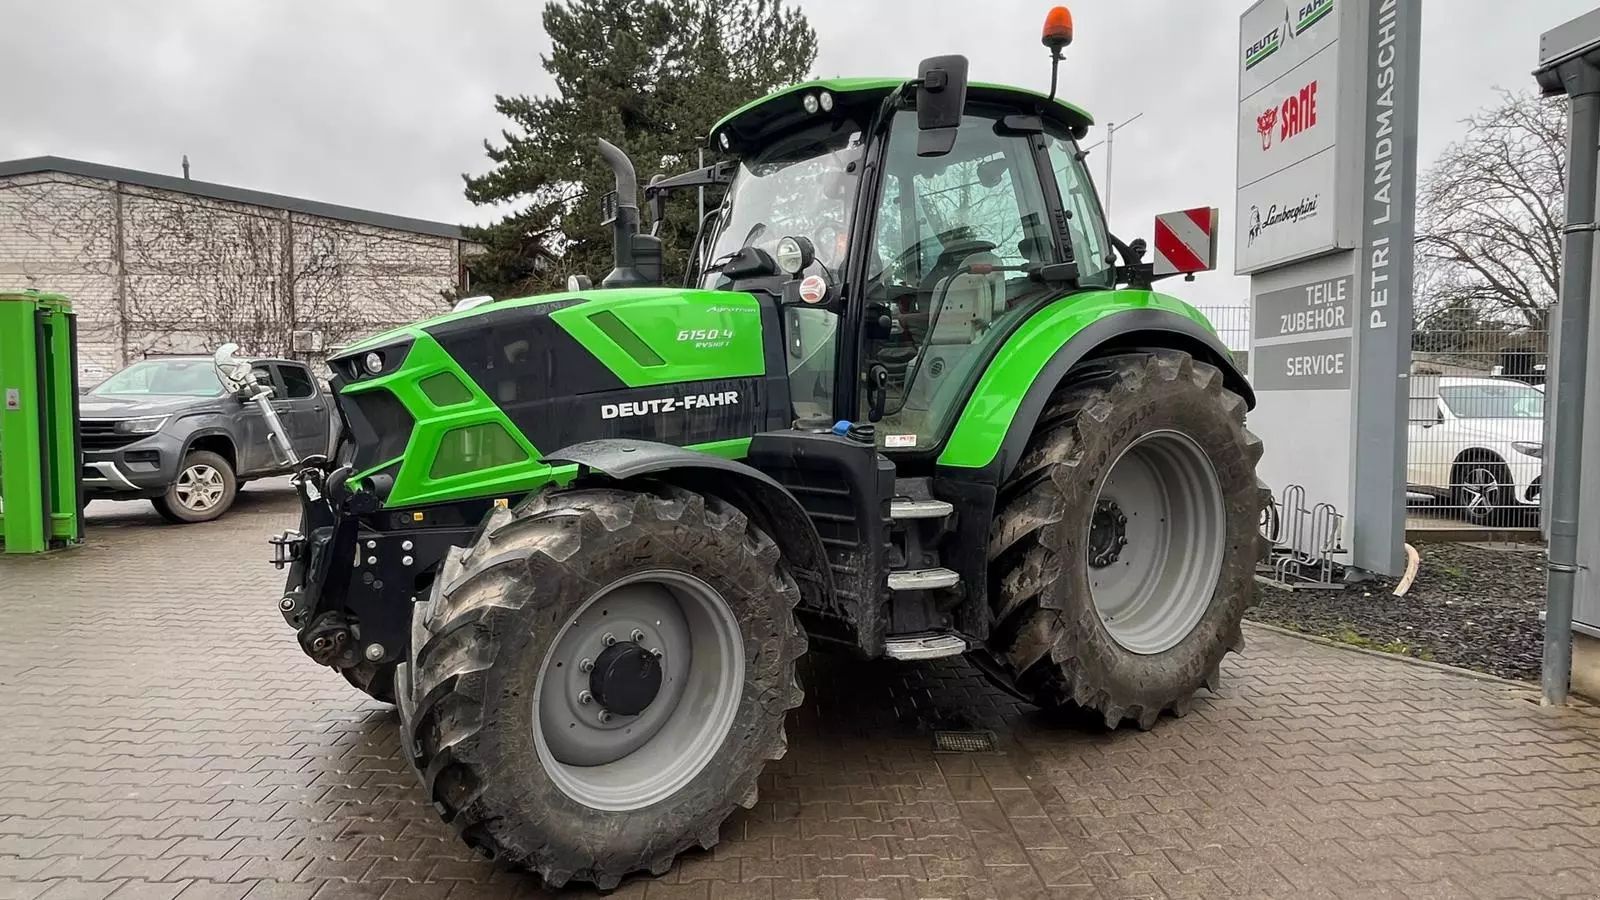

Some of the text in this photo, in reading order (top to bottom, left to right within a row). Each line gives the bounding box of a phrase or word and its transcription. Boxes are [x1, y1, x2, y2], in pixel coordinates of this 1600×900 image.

[1245, 0, 1326, 59] DEUTZ FAH
[1281, 80, 1317, 142] SAME
[1262, 194, 1317, 228] Lamborghini
[1306, 279, 1346, 306] TEILE
[1370, 237, 1390, 329] PETRI
[1280, 303, 1345, 334] ZUBEHÖR
[1286, 353, 1345, 377] SERVICE
[601, 391, 739, 419] DEUTZ-FAHR
